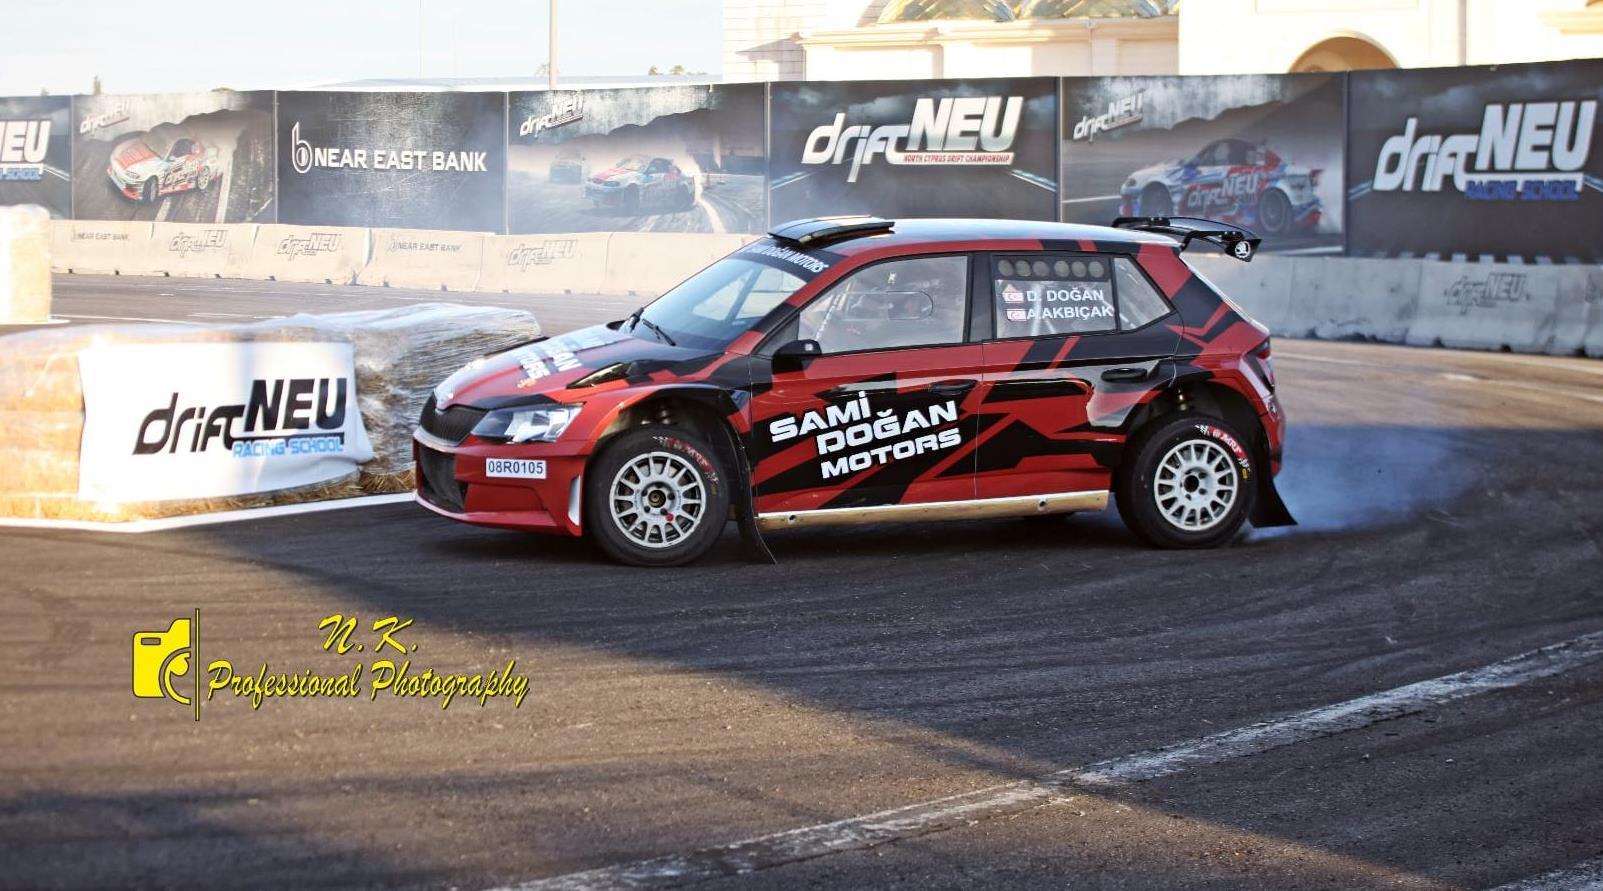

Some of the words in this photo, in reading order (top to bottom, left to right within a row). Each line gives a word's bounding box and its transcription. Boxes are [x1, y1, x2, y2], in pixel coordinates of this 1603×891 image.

[315, 148, 367, 169] NEAR
[374, 150, 427, 170] EAST
[432, 151, 487, 171] BANK
[1046, 287, 1104, 302] DOĞAN
[816, 400, 959, 456] DOĞAN
[233, 438, 286, 458] RACING
[290, 436, 344, 455] SCHOOL
[820, 427, 962, 479] MOTORS
[487, 460, 544, 475] 08R0105
